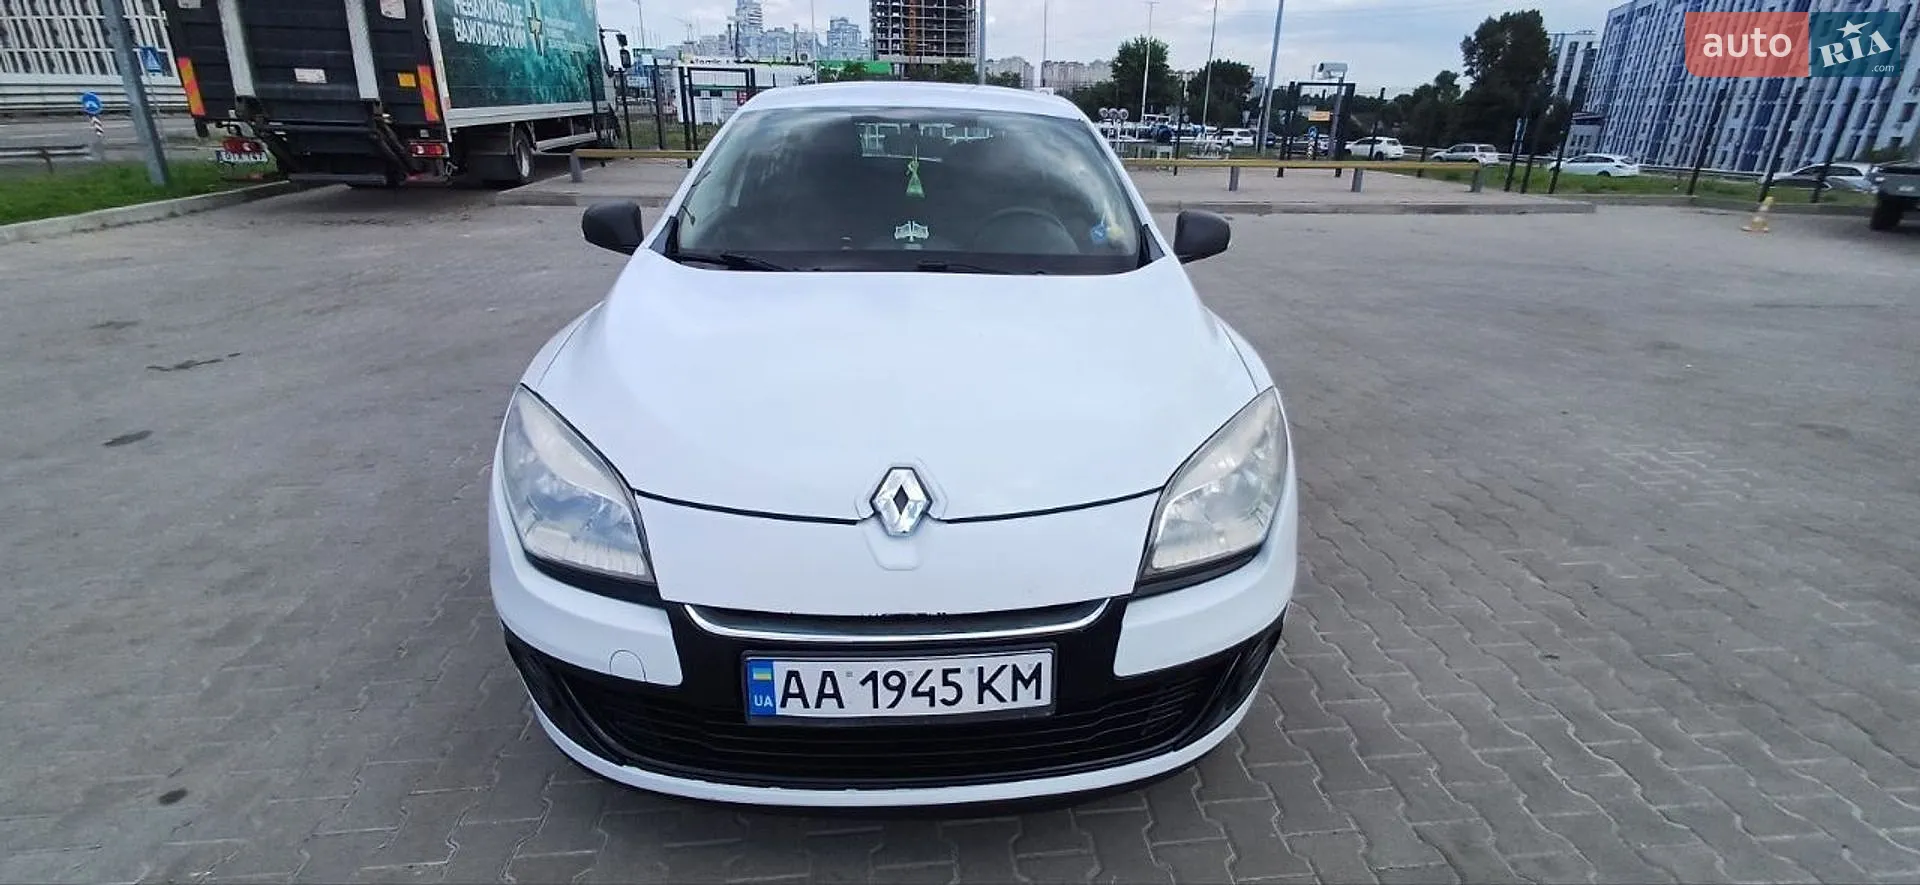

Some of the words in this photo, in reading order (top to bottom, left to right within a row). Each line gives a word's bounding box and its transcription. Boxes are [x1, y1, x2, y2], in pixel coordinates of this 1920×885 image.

[453, 17, 503, 47] ВАЖЛИВО
[779, 670, 845, 709] AA
[859, 667, 963, 709] 1945
[977, 662, 1042, 705] KM
[754, 695, 774, 708] UA
